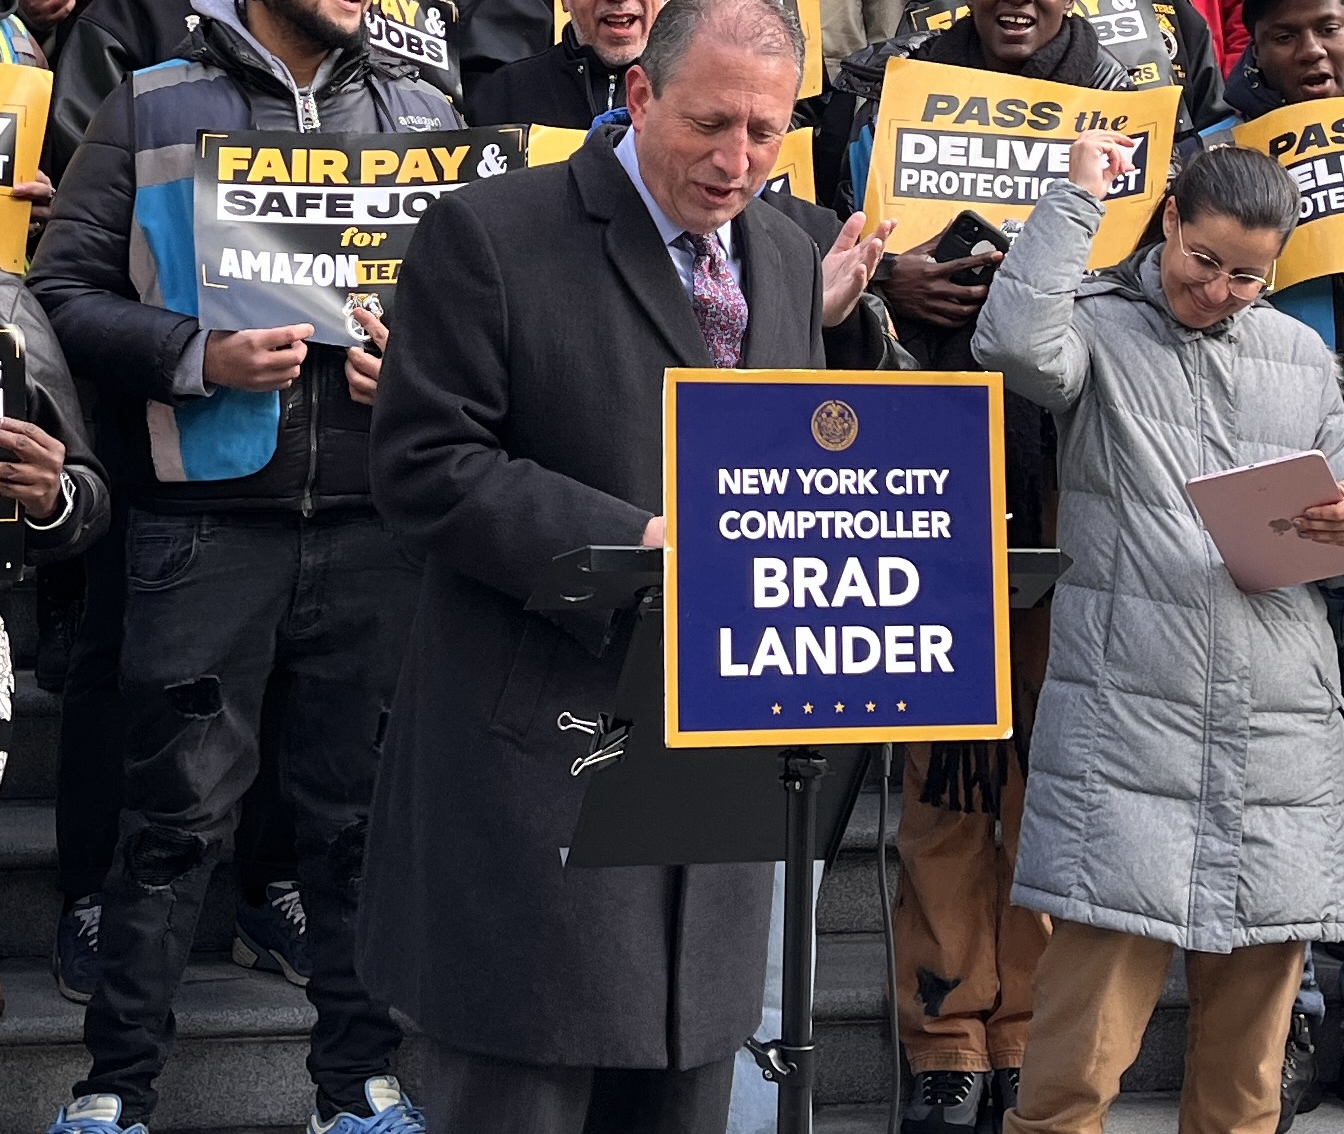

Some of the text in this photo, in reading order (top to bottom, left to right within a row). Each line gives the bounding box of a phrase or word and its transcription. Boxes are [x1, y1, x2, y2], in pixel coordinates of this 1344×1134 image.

[424, 7, 446, 38] &
[1094, 17, 1140, 42] BS
[921, 93, 1129, 132] PASS the
[217, 143, 507, 184] FAIR PAY &
[1107, 169, 1141, 195] CT
[223, 189, 454, 219] SAFE JO
[340, 226, 387, 248] for
[219, 248, 359, 288] AMAZON
[718, 468, 950, 495] NEW YORK CITY
[718, 509, 952, 540] COMPTROLLER
[752, 556, 921, 609] BRAD
[719, 624, 955, 678] LANDER
